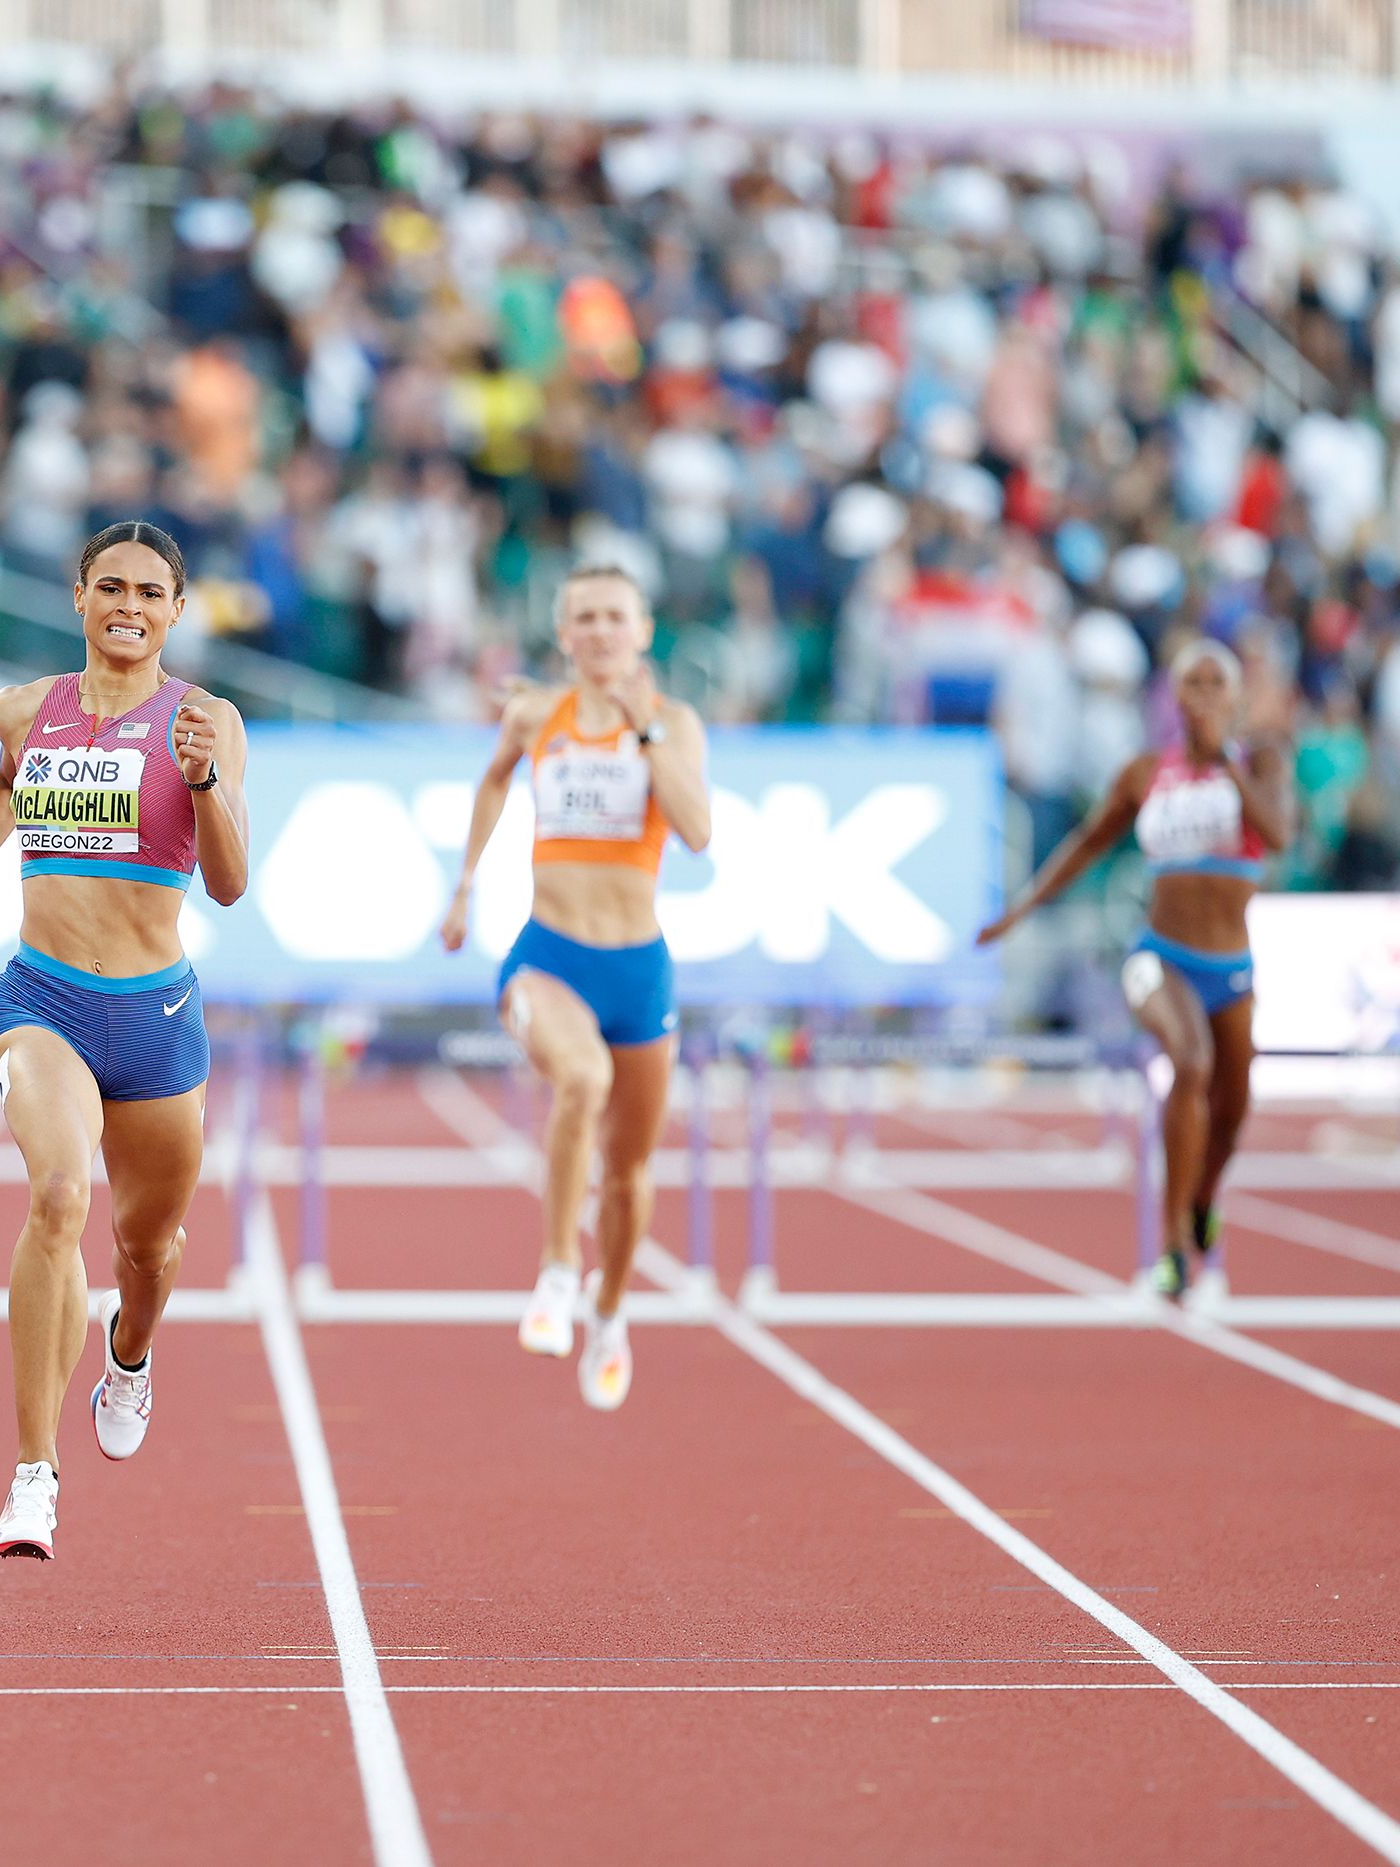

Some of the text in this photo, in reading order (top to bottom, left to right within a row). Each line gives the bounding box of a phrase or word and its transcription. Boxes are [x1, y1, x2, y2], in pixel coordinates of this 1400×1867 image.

[58, 759, 120, 783] QNB
[13, 788, 131, 823] McLAUGHLIN
[21, 833, 113, 850] OREGON22
